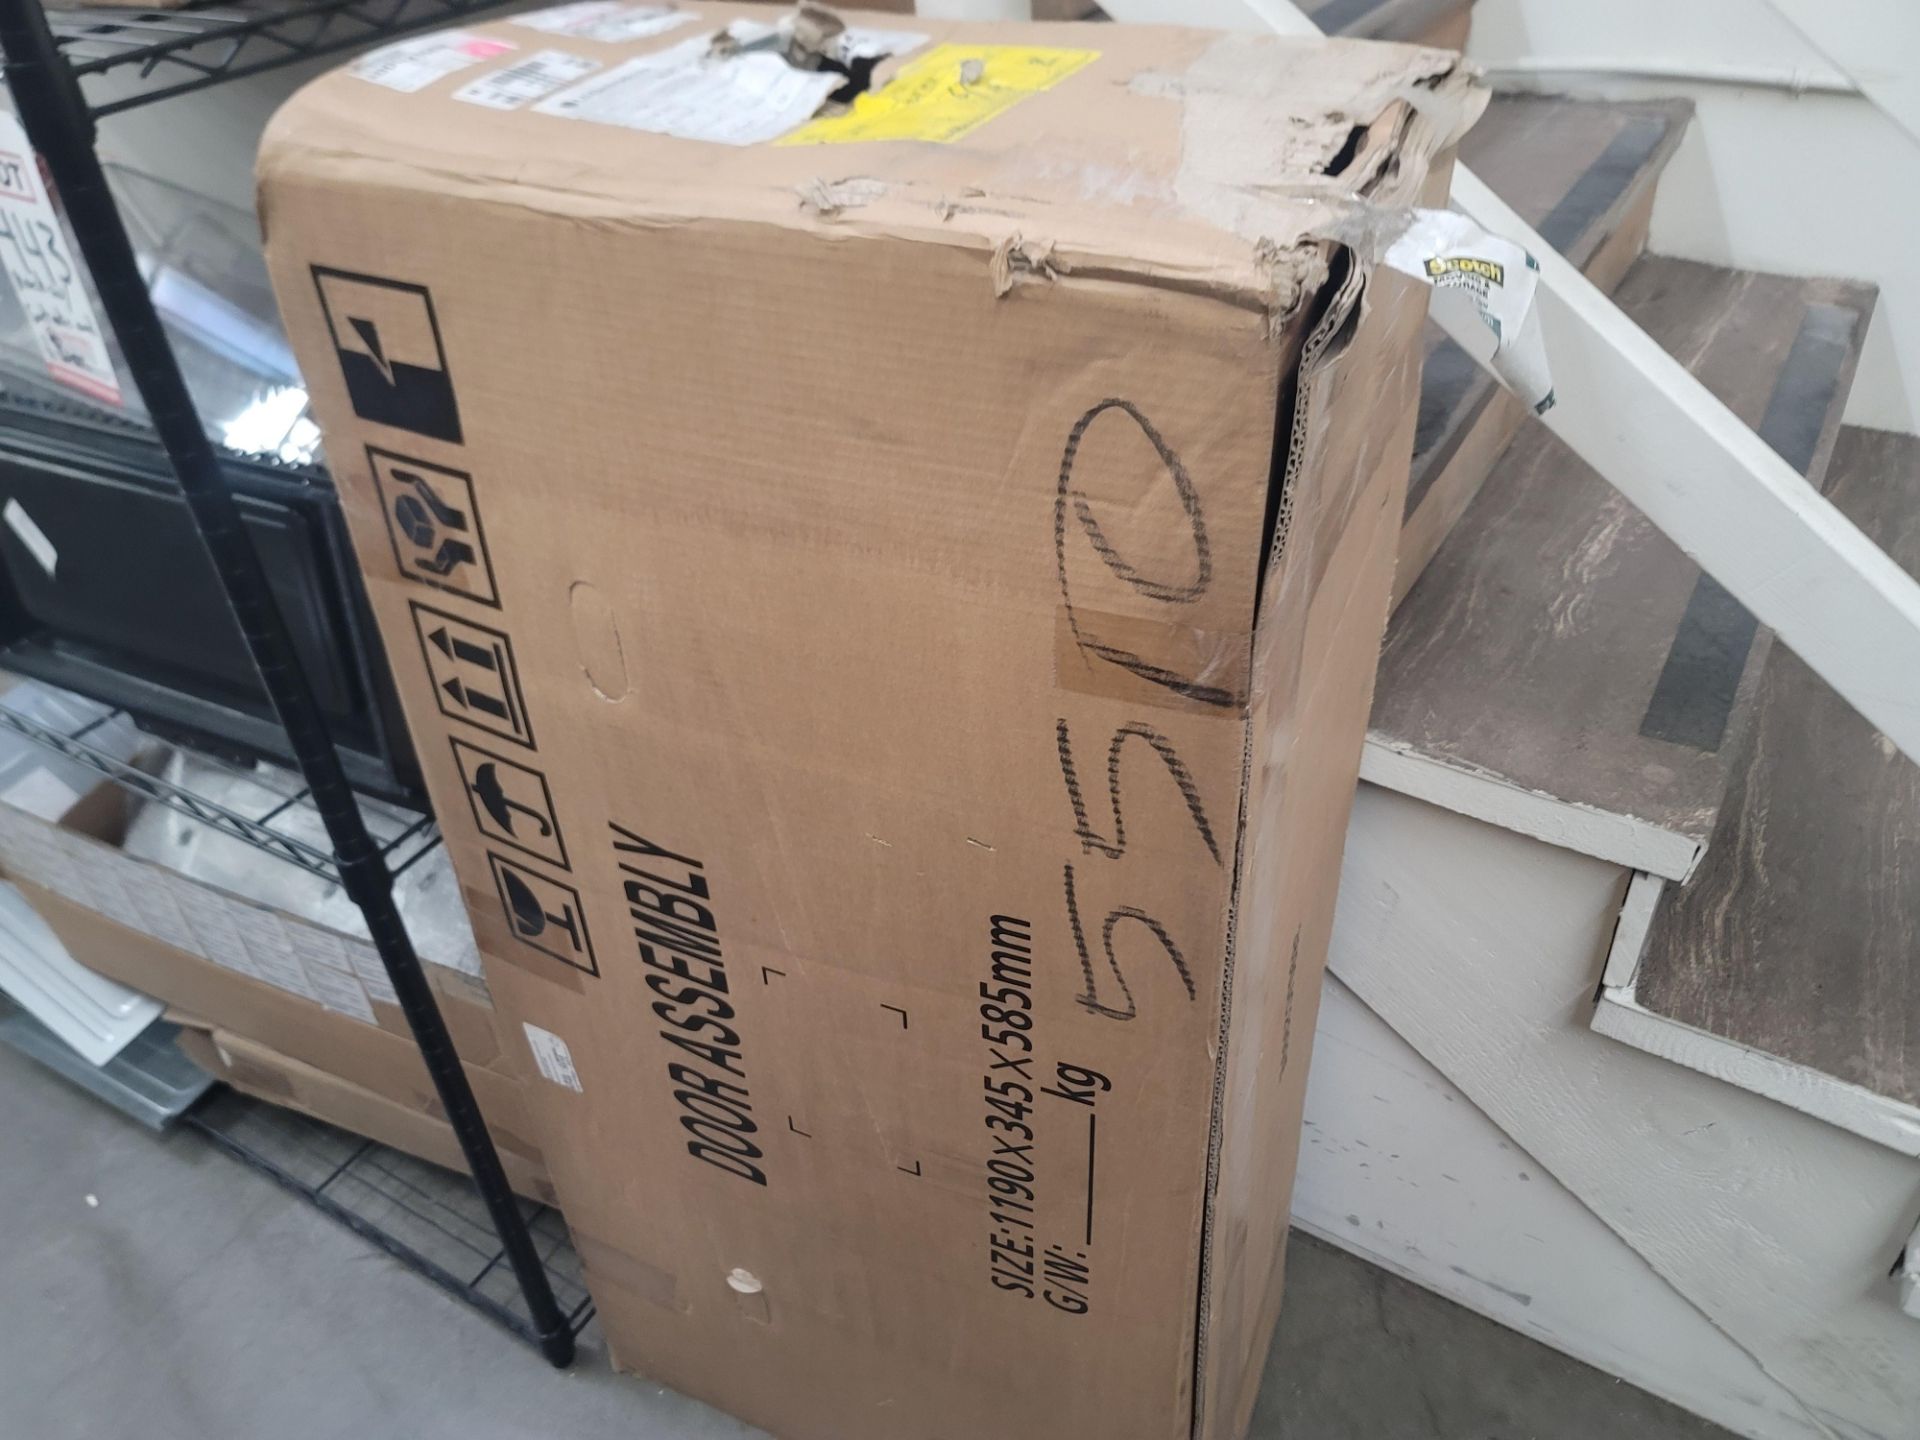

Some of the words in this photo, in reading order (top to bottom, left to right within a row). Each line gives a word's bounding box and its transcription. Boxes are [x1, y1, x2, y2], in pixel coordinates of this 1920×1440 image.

[1429, 258, 1502, 283] Scotch
[608, 820, 746, 1078] ASSEMBLY
[668, 1062, 767, 1186] DOOR
[1040, 1061, 1112, 1107] kg
